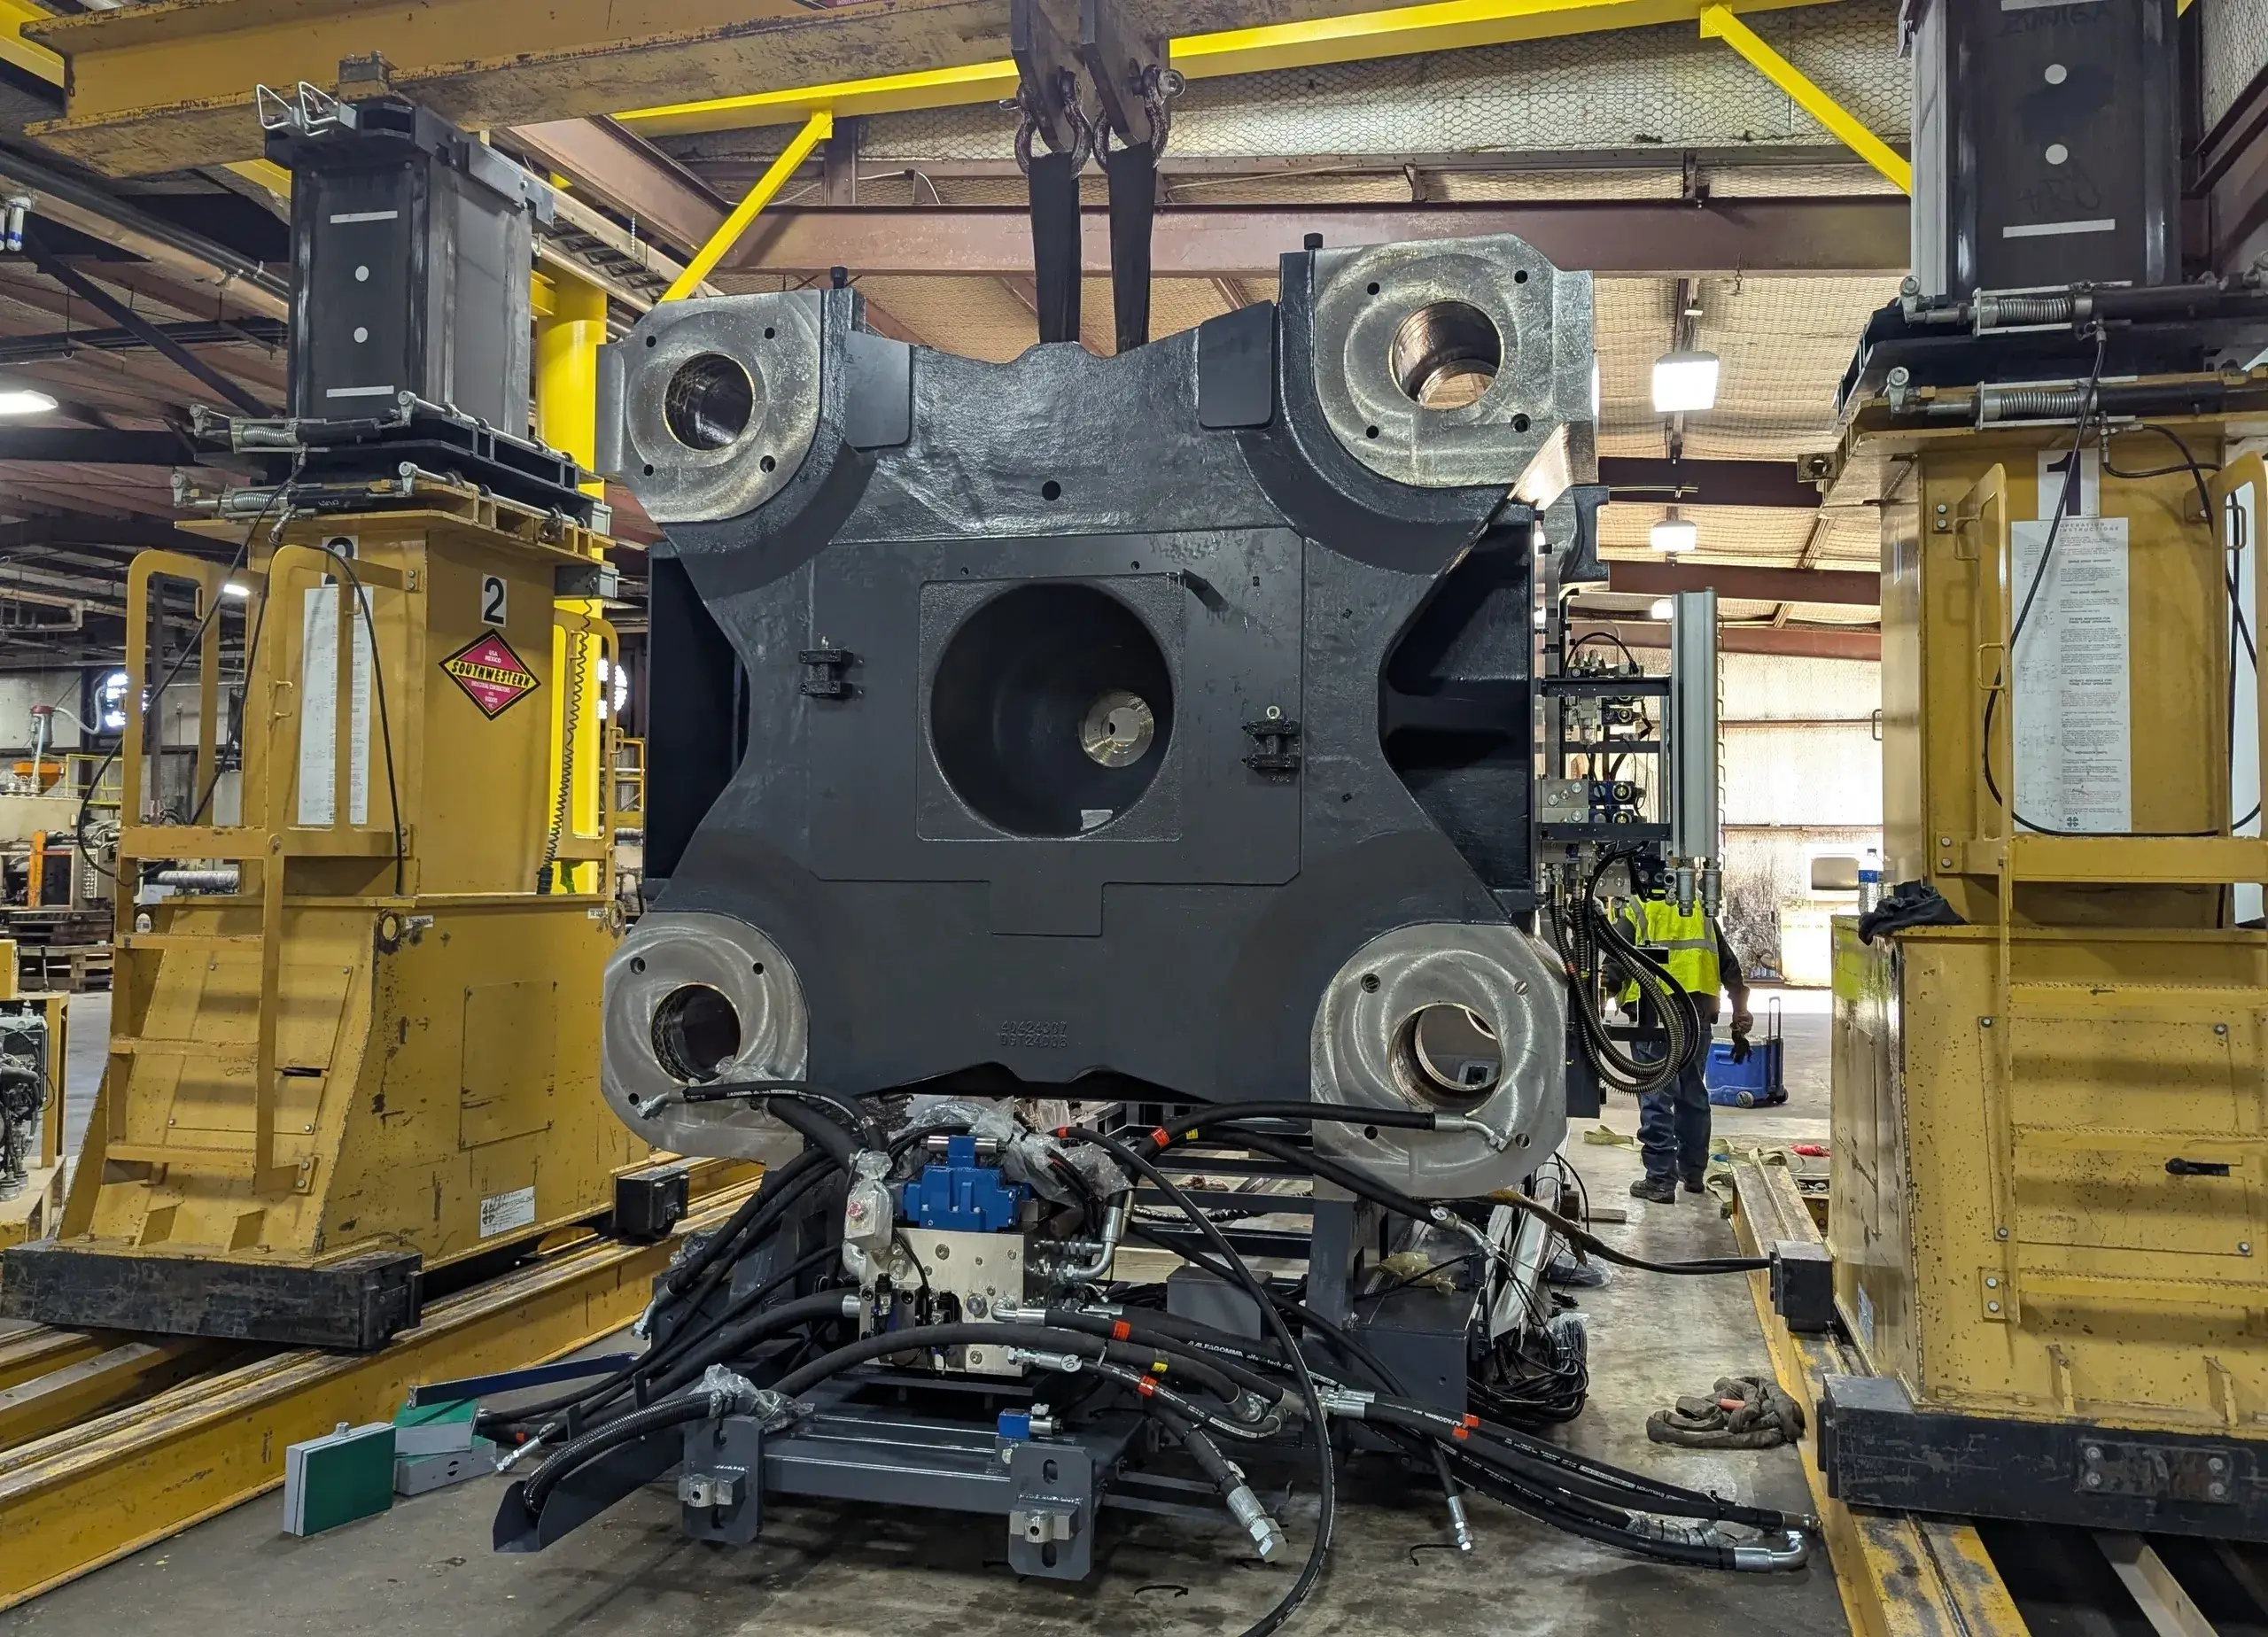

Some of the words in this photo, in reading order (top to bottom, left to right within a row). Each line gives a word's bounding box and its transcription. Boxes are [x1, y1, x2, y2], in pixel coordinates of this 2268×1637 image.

[2047, 451, 2082, 516] 1
[483, 577, 505, 625] 2
[485, 655, 502, 663] MEXICO
[451, 661, 532, 687] SOUTHWESTERN
[1193, 1342, 1244, 1357] ALFAGOMMA
[1063, 1358, 1076, 1369] 10
